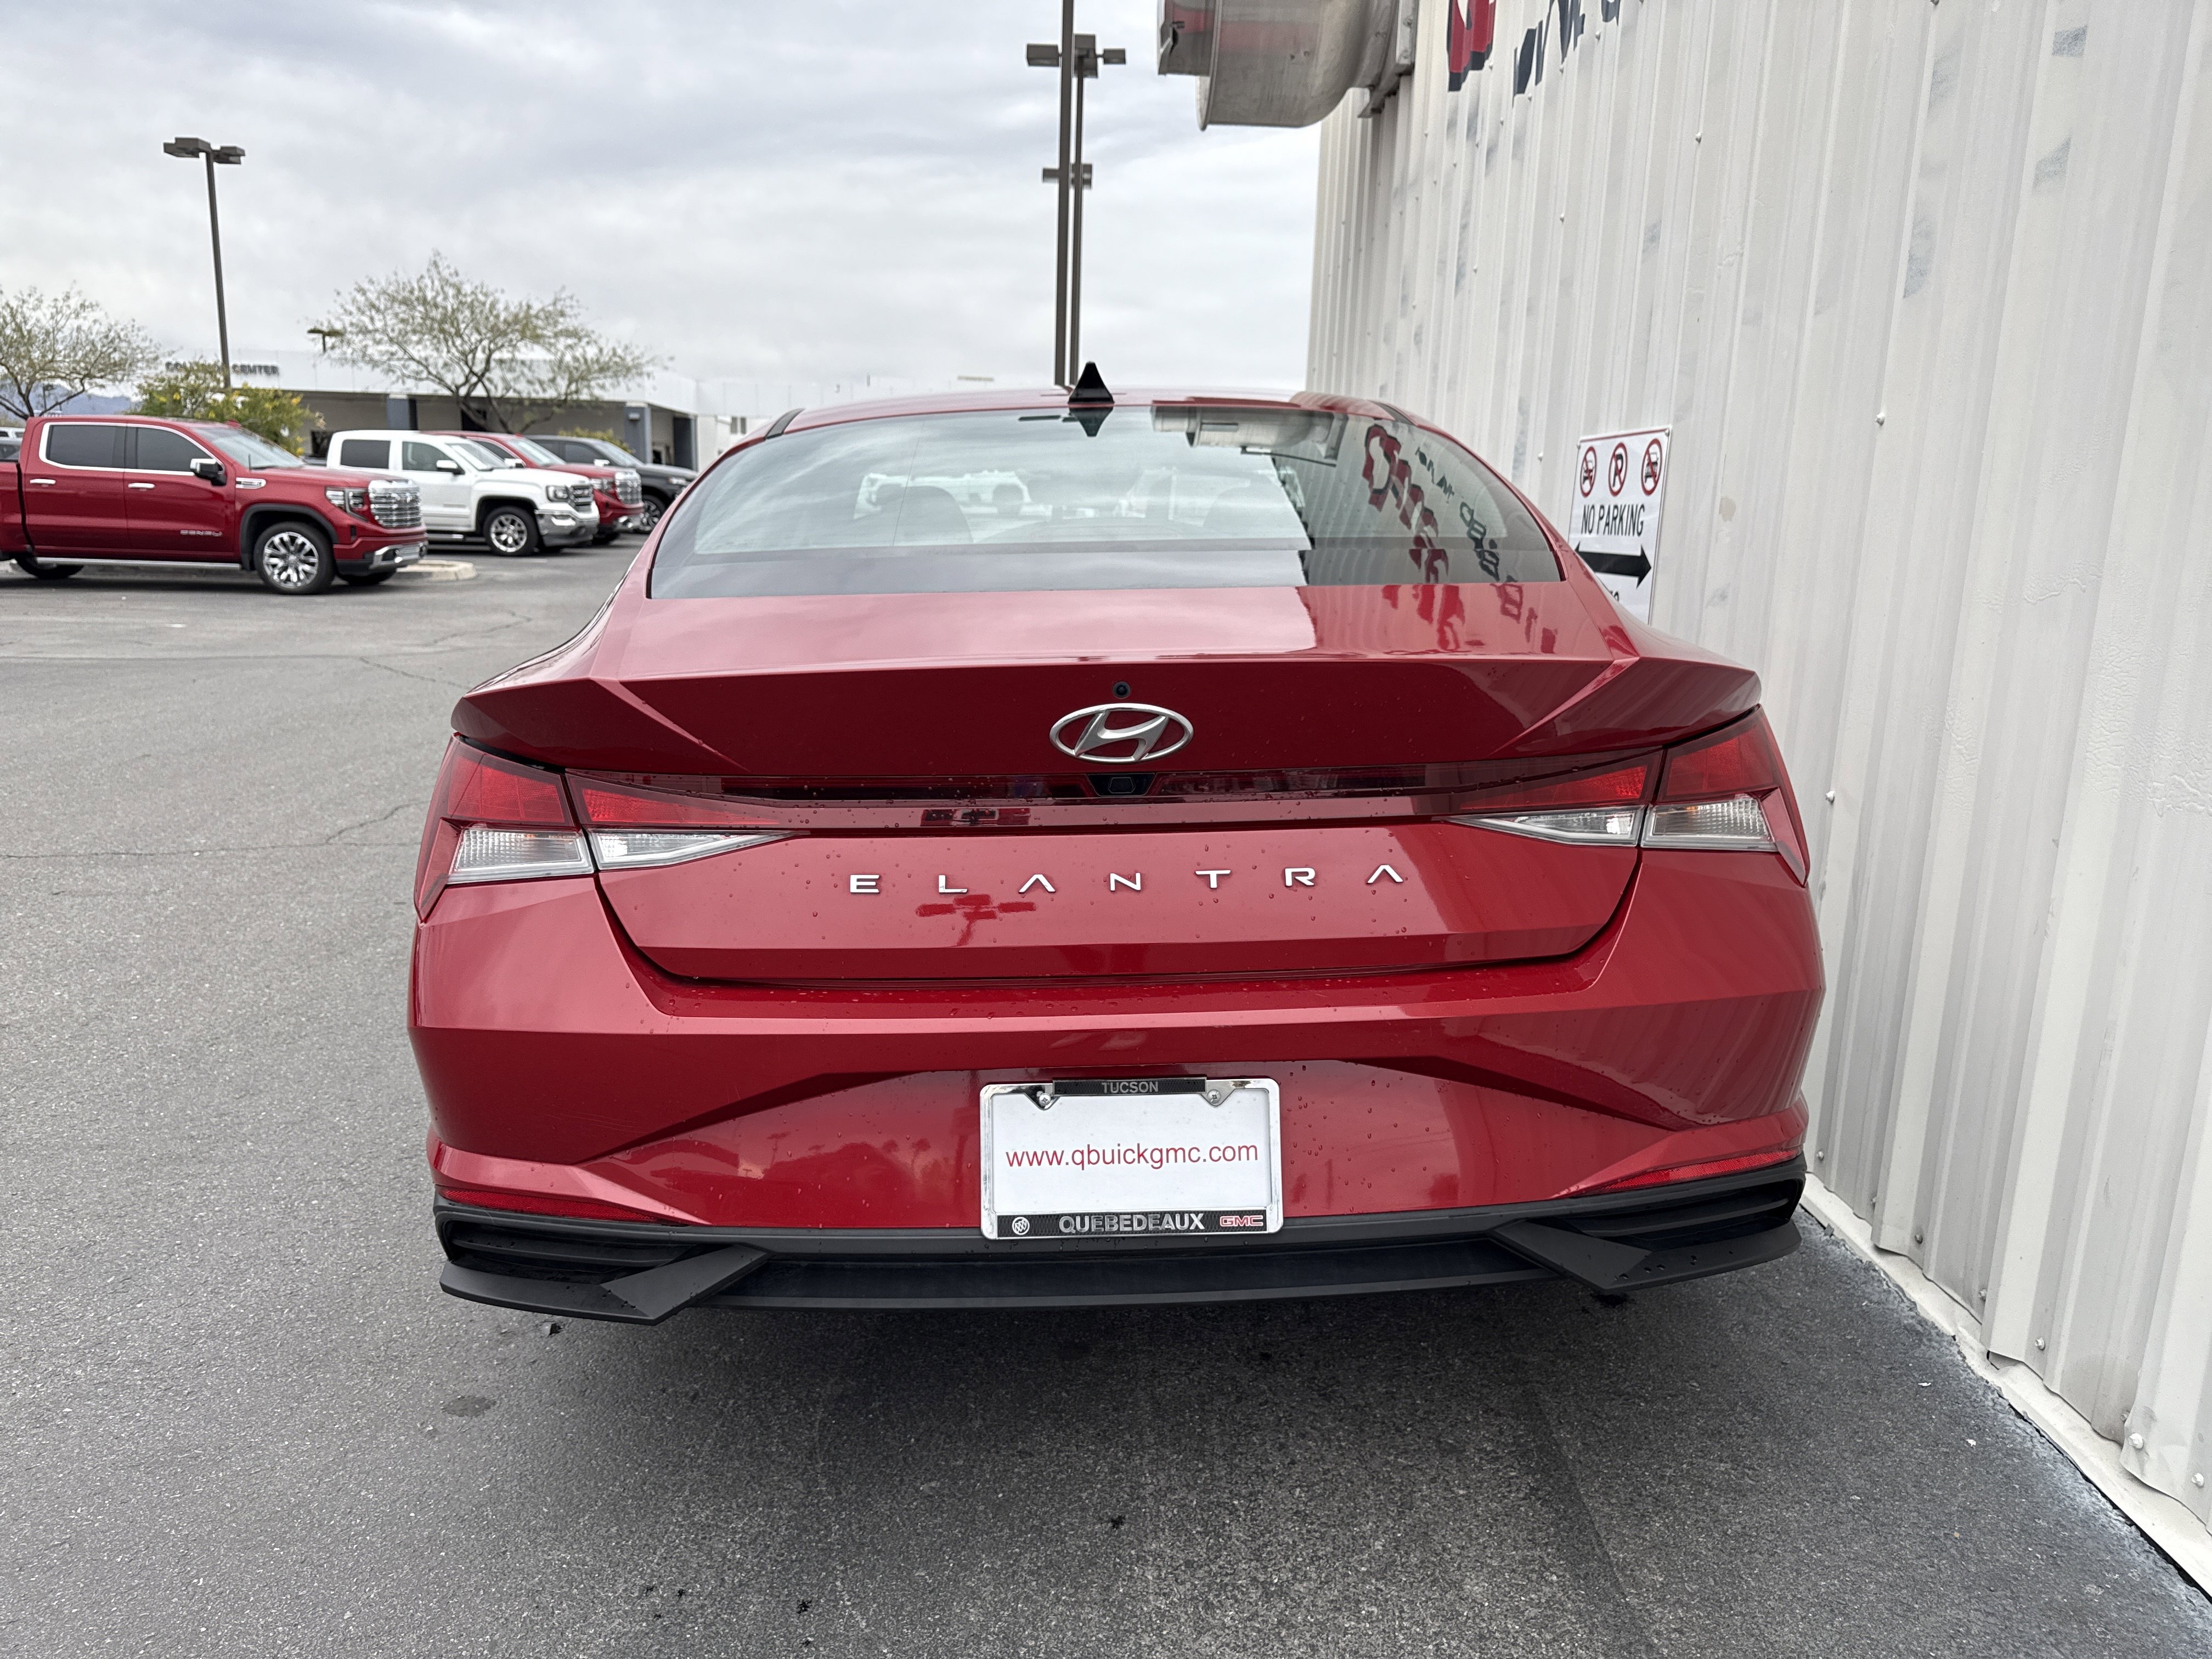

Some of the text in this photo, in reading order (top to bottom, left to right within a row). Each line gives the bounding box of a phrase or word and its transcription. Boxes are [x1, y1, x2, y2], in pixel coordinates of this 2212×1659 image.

[232, 364, 279, 375] CENTER
[1581, 504, 1645, 537] NO PARKING
[849, 864, 1403, 895] ELANTRA
[1102, 1081, 1159, 1093] TUCSON
[1005, 1143, 1259, 1171] www.qbuickgmc.com
[1059, 1213, 1205, 1234] QUEBEDEAUX
[1219, 1215, 1264, 1227] GMC
